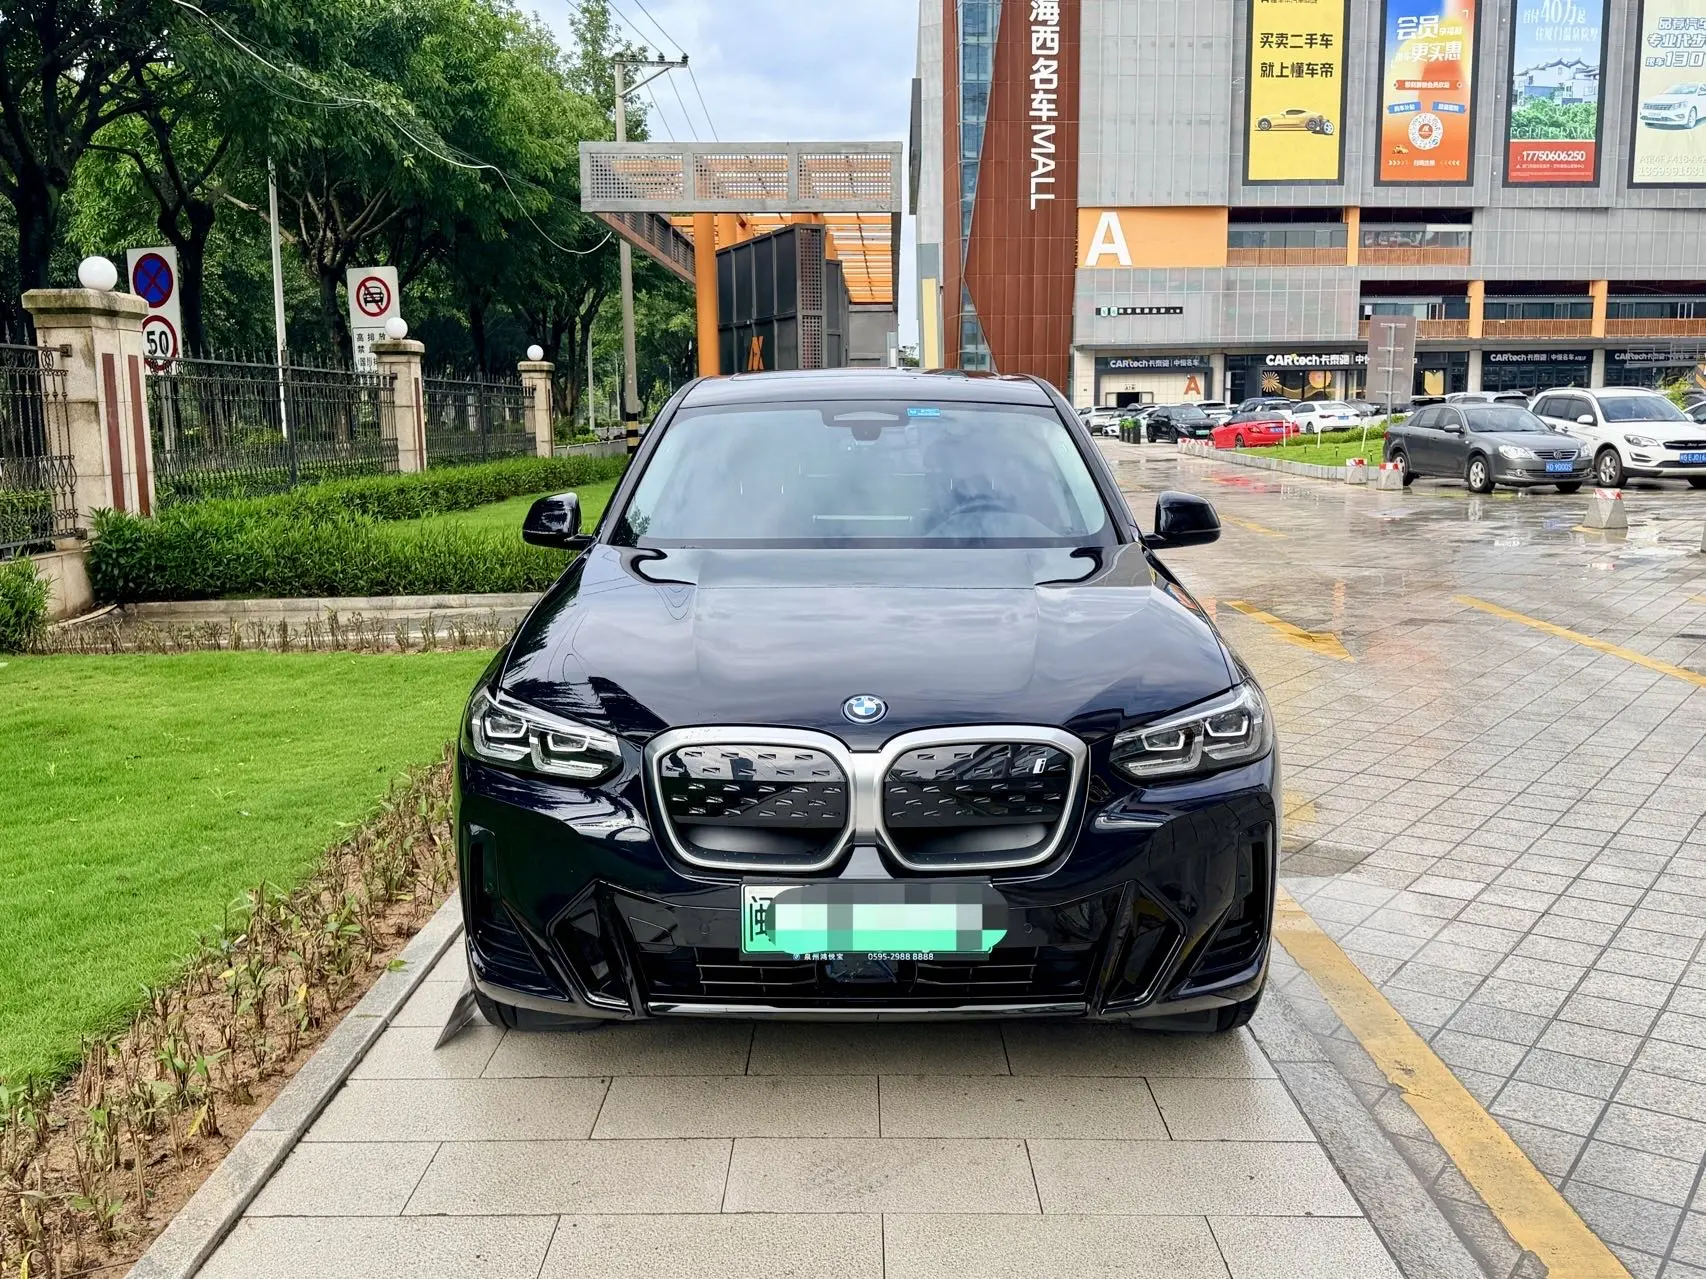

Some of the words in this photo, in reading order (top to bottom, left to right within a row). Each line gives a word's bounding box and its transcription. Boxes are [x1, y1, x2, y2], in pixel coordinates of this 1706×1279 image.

[1260, 32, 1334, 49] 买卖二手车
[1260, 62, 1334, 78] 就上懂车帝
[1522, 150, 1586, 162] 17750606250
[1085, 212, 1132, 267] A
[146, 330, 169, 356] 50
[1184, 375, 1201, 395] A
[867, 952, 910, 961] 0595-2988
[912, 952, 934, 961] 8888
